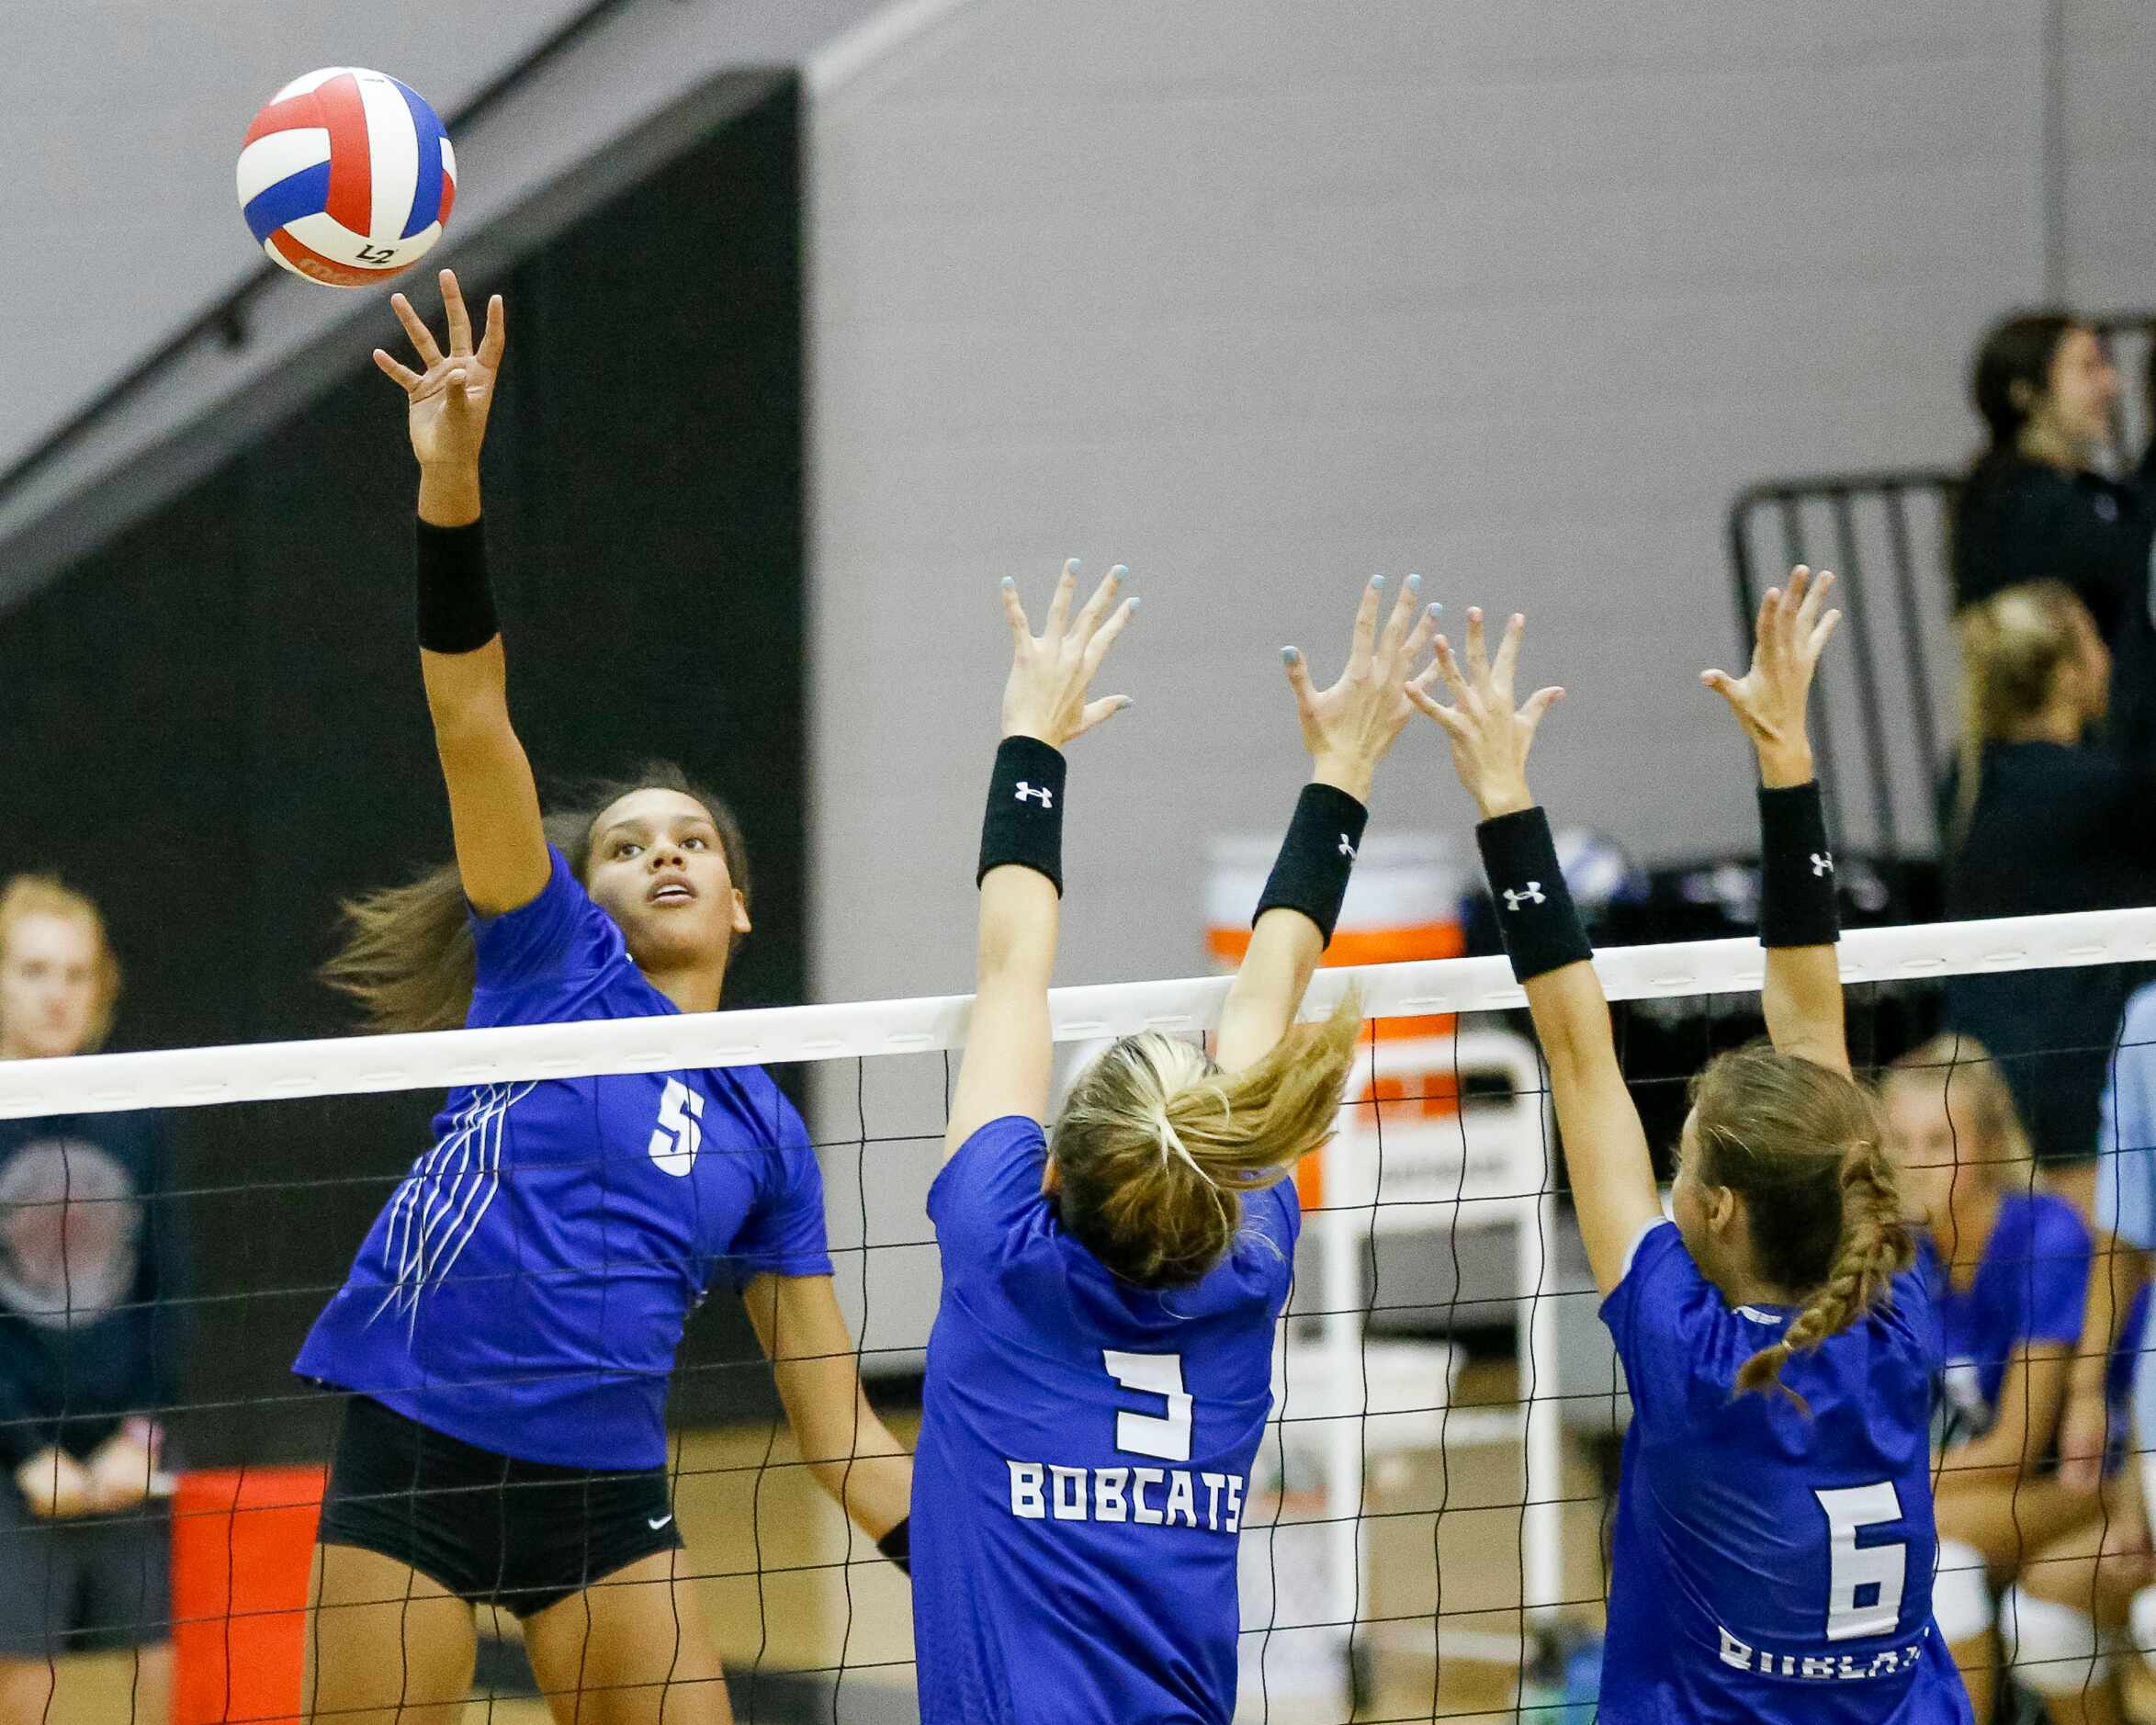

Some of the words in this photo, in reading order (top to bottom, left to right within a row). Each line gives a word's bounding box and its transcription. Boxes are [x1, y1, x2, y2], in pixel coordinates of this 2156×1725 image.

[648, 1076, 705, 1178] 5
[1102, 1349, 1193, 1461] 3
[1007, 1460, 1243, 1534] BOBCATS
[1815, 1481, 1906, 1641] 6
[1718, 1625, 1930, 1680] BOBCA
